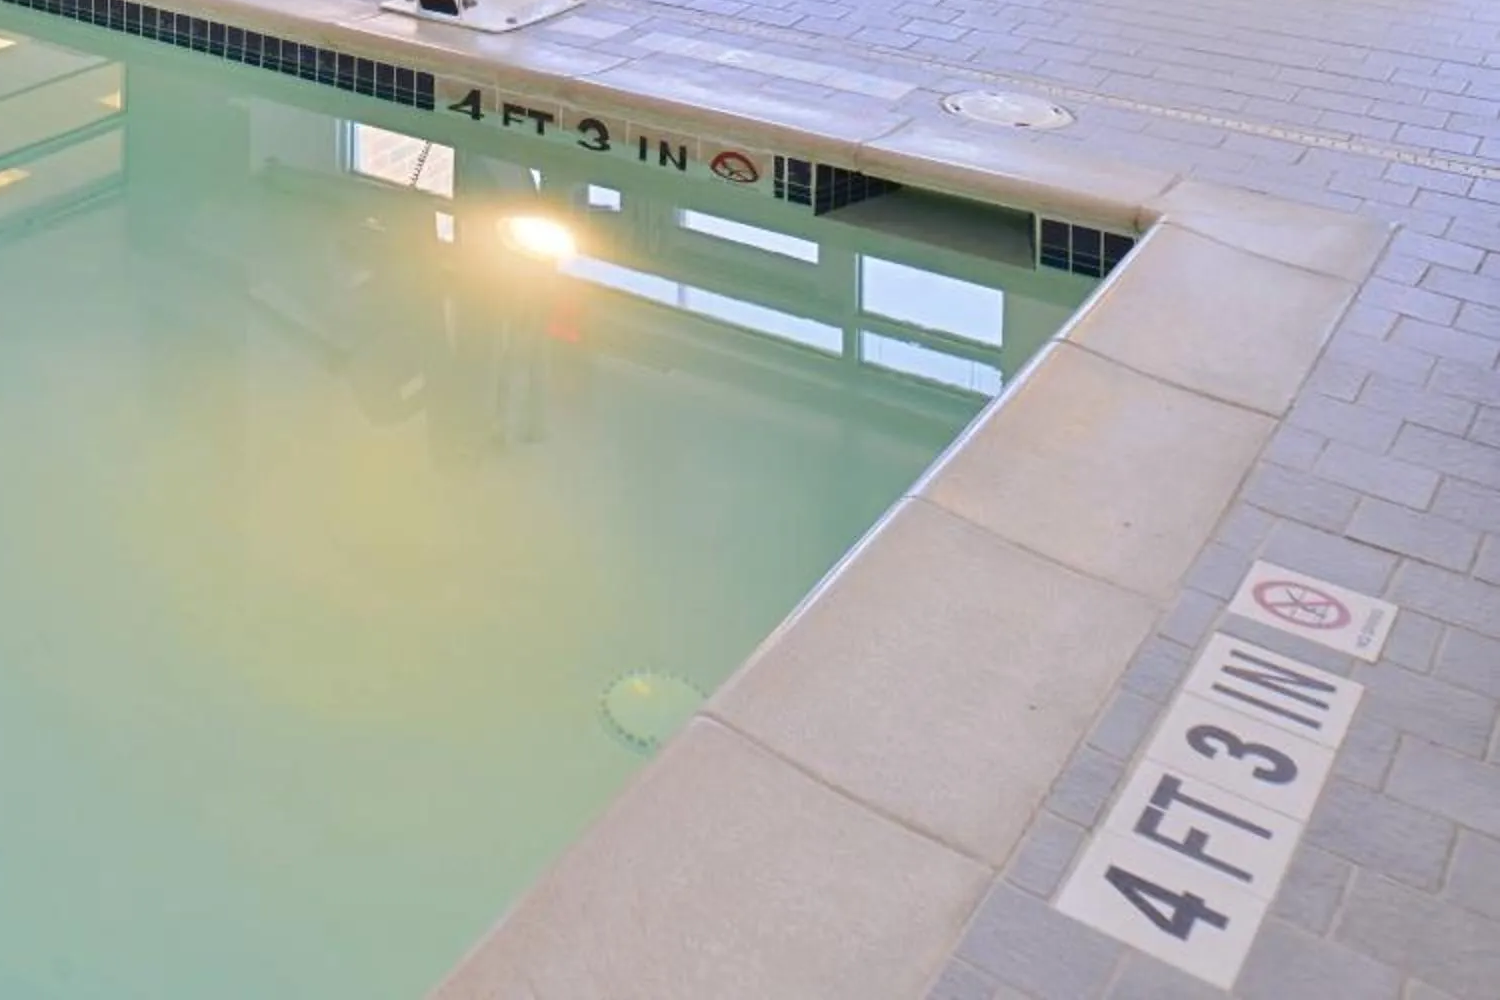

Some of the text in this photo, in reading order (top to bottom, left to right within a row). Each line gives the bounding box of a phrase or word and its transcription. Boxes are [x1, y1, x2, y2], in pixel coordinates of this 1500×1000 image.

[448, 89, 687, 172] 4 FT 3 IN
[1104, 649, 1337, 941] 4 FT 3 IN
